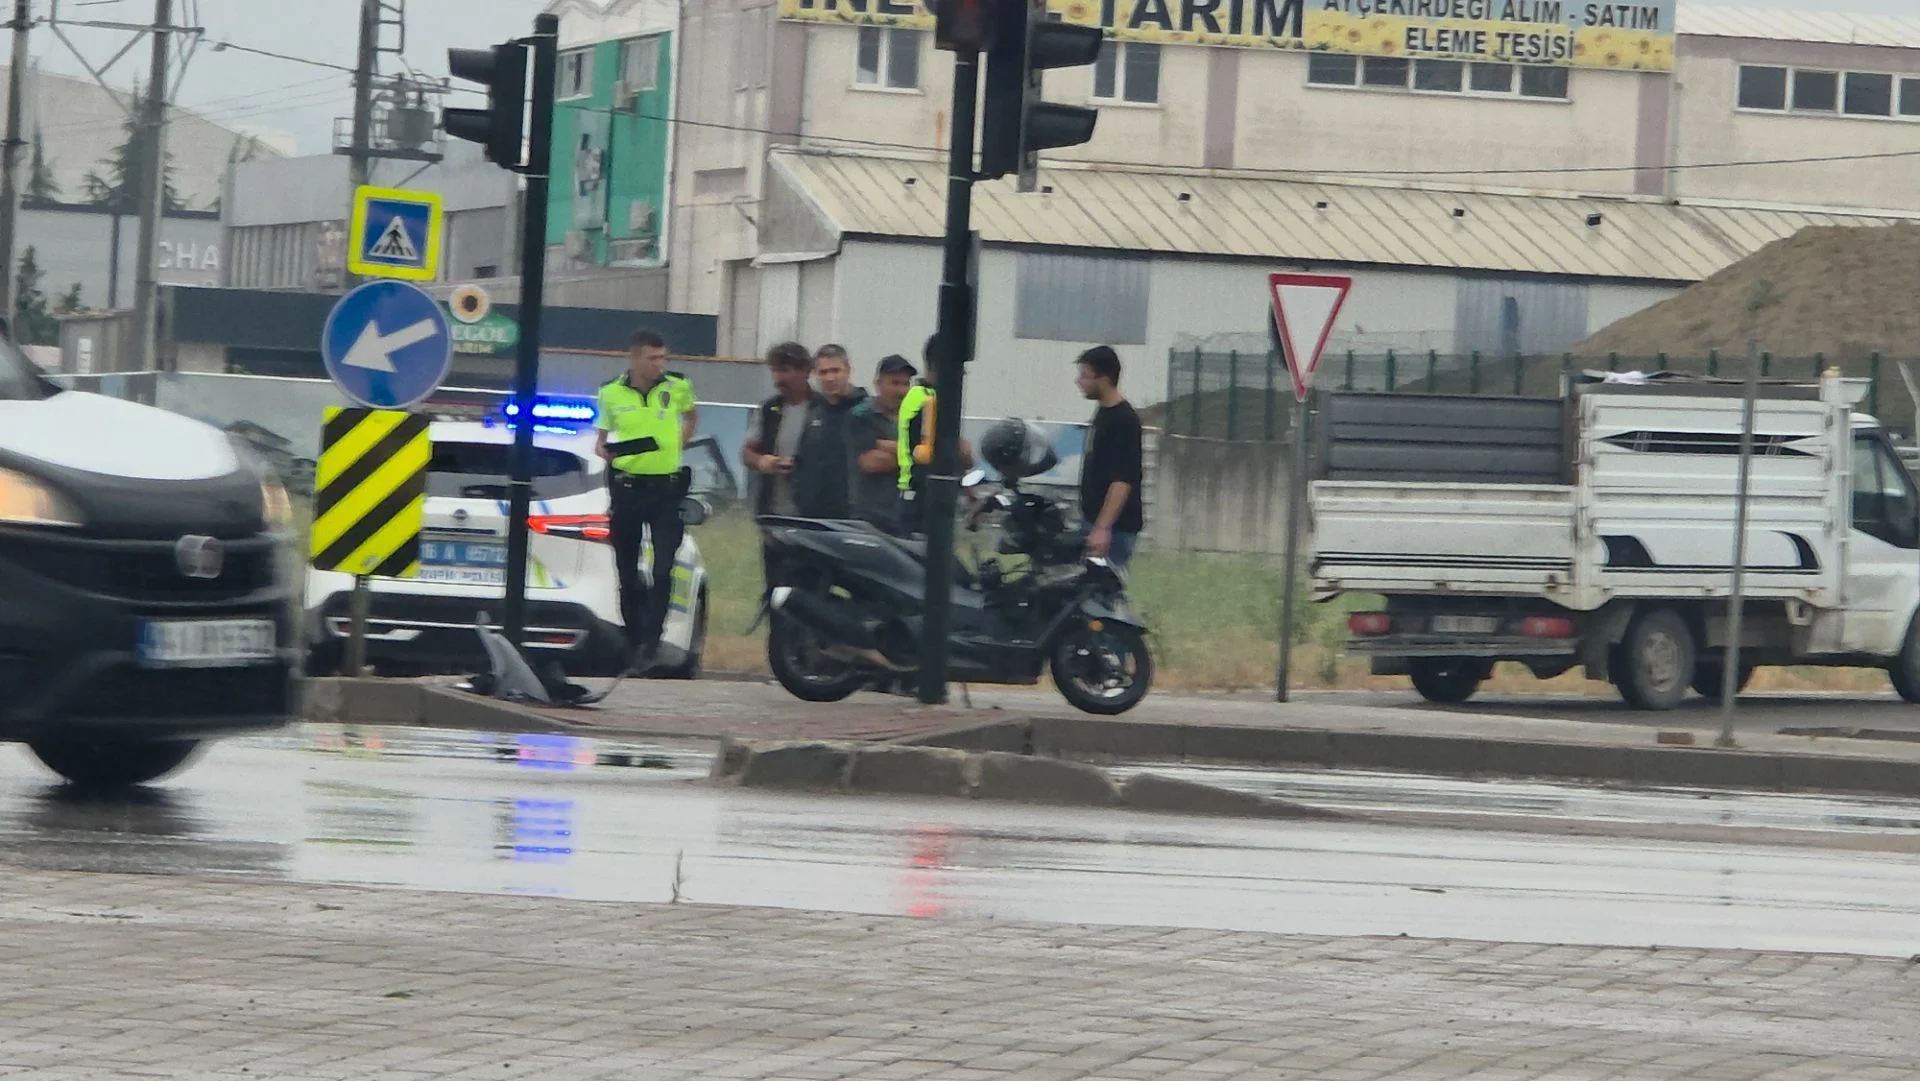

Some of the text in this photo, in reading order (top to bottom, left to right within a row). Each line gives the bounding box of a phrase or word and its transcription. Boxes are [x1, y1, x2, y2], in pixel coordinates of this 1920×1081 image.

[1501, 0, 1560, 24] ALIM
[1583, 4, 1659, 30] SATIM
[1405, 27, 1574, 58] ELEME TESİSİ
